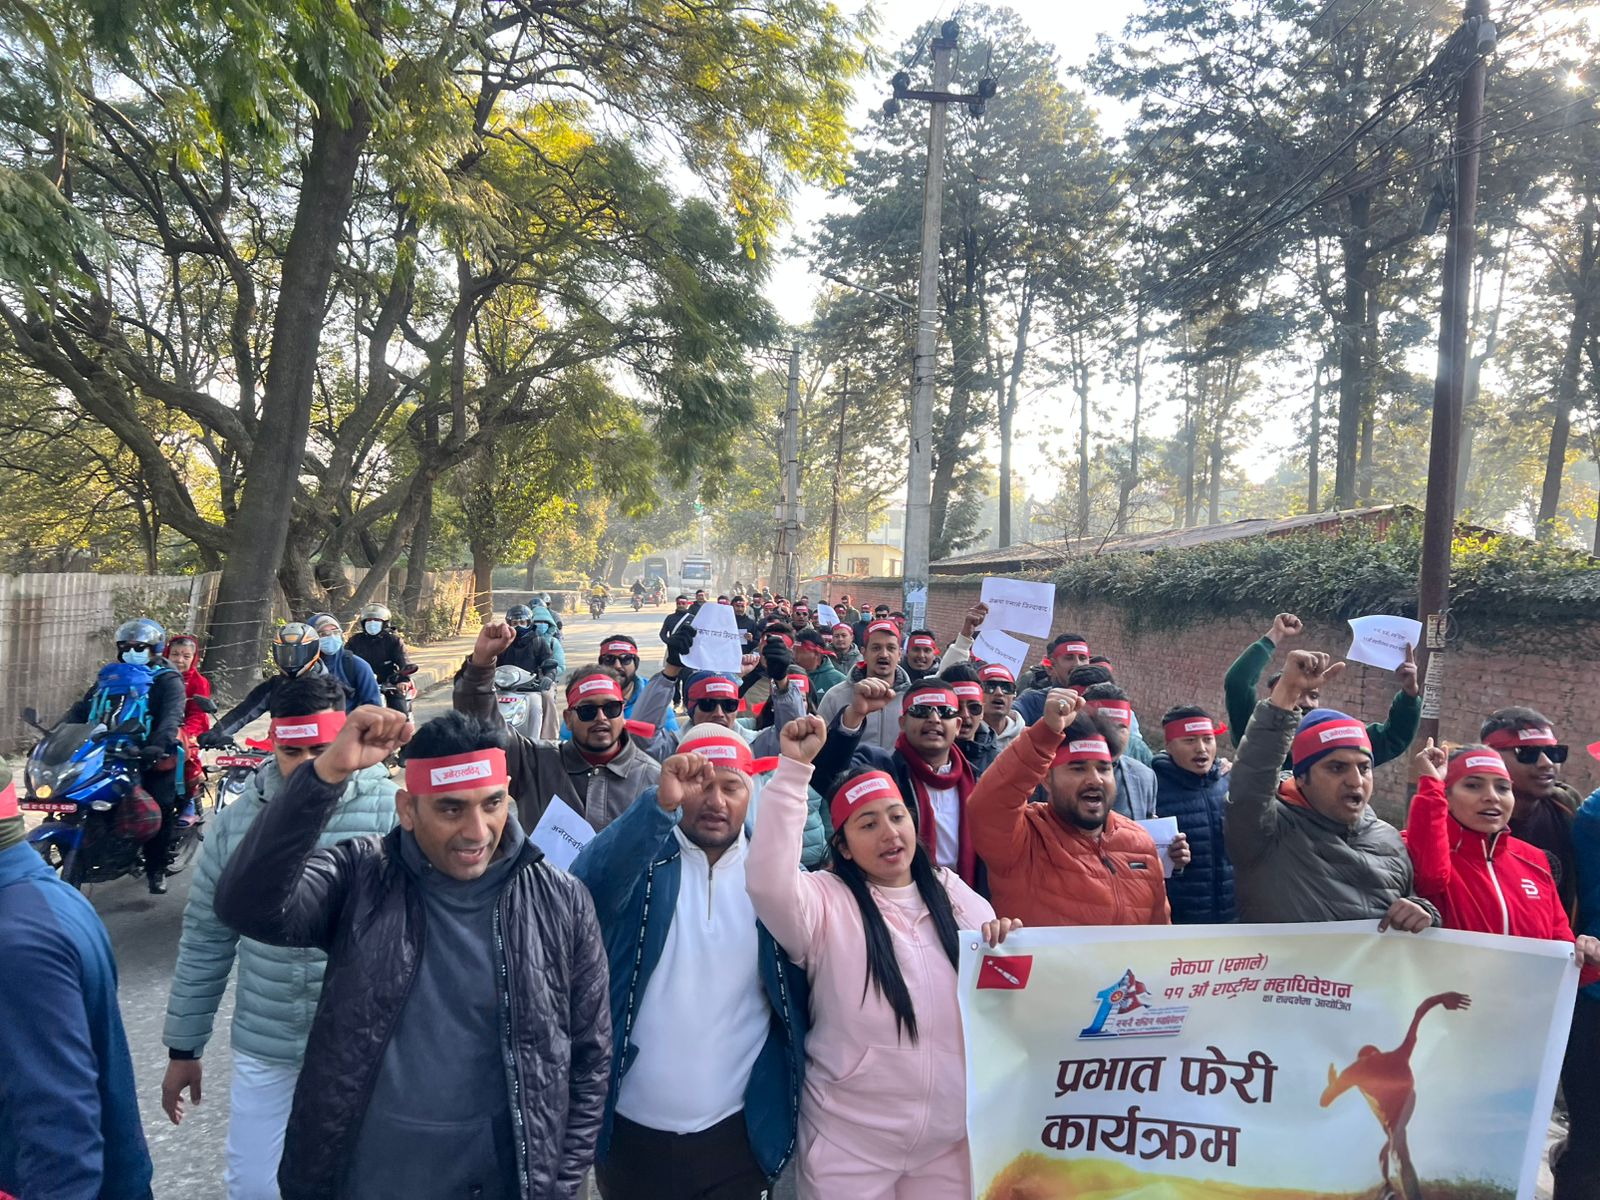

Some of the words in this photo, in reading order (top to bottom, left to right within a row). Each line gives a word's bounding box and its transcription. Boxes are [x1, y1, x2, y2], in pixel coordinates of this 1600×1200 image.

[1170, 957, 1214, 976] नेकपा
[1218, 953, 1268, 975] (एमाले)
[1164, 987, 1184, 999] ११
[1211, 977, 1262, 999] राष्ट्रीय
[1263, 974, 1354, 998] महाधिवेशन
[1314, 998, 1352, 1011] आयोजित
[1055, 1056, 1167, 1098] प्रभात
[1180, 1046, 1278, 1103] फेरी
[1041, 1105, 1241, 1167] कार्यक्रम
